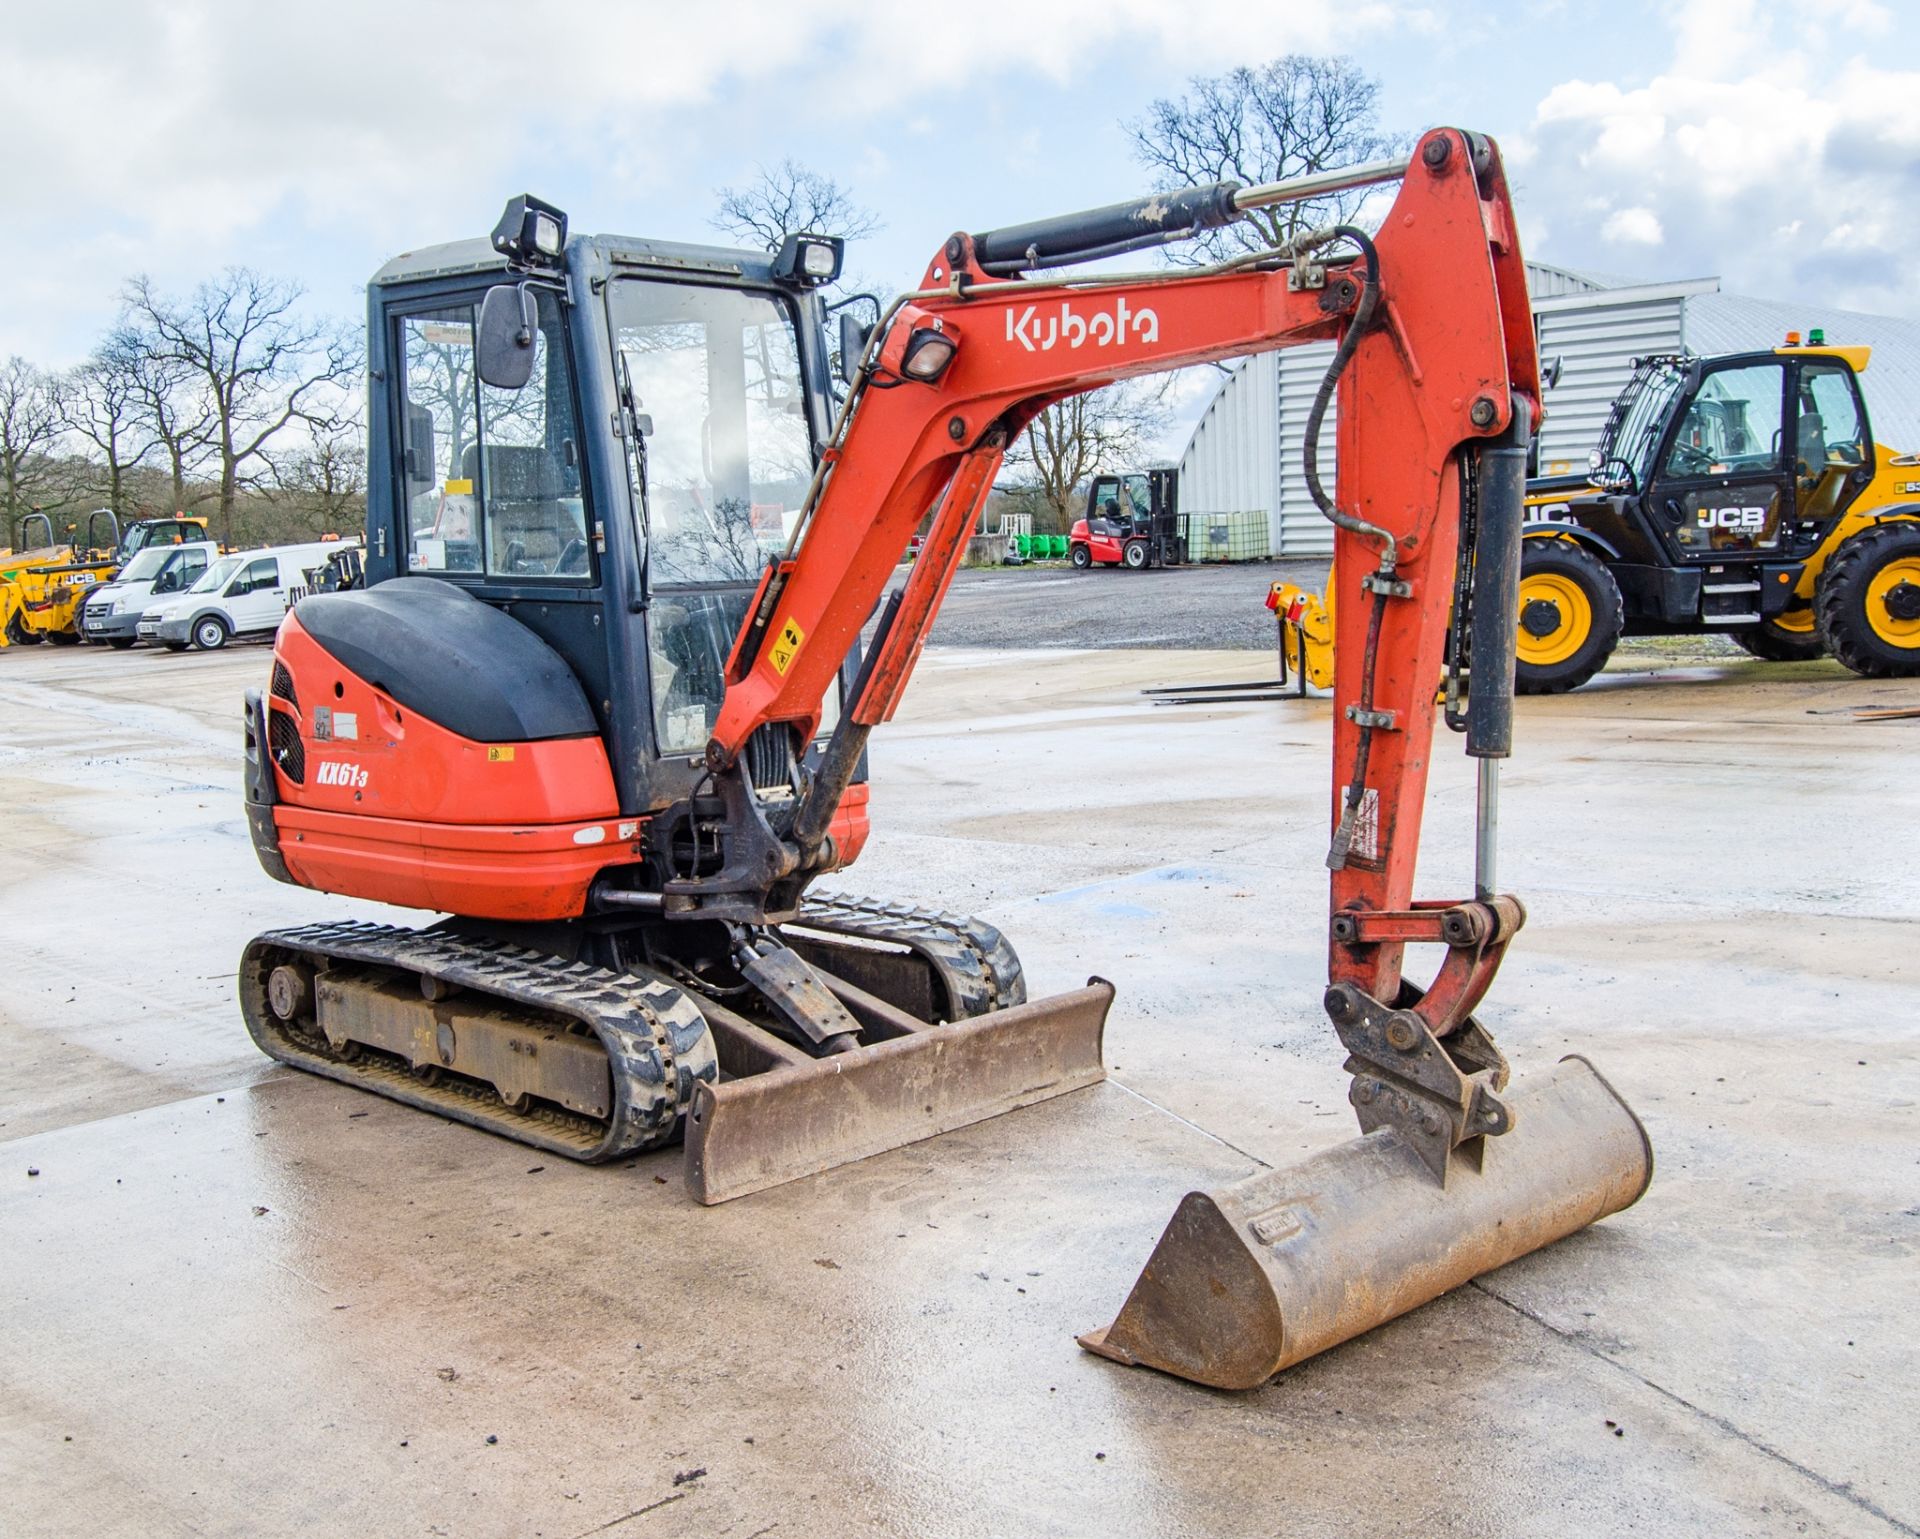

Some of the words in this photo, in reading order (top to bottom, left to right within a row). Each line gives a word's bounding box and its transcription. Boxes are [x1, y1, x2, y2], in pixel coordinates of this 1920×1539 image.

[1006, 298, 1158, 351] Kubota
[1697, 507, 1765, 528] JCB
[65, 573, 96, 585] JCB
[316, 762, 368, 787] KX61-3
